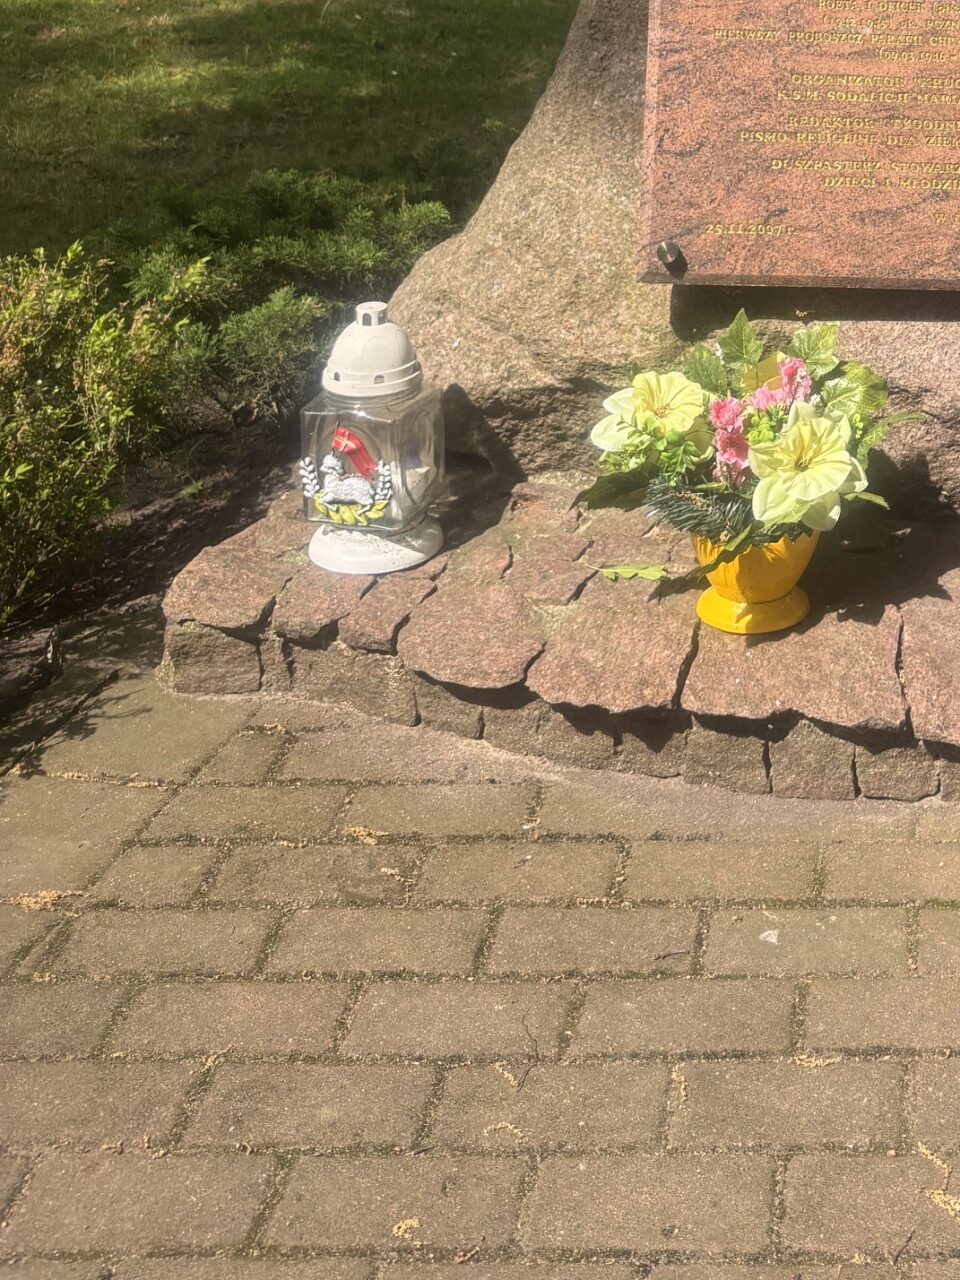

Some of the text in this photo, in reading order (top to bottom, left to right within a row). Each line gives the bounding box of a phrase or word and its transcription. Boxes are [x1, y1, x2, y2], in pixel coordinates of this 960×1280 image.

[818, 0, 858, 11] POETA
[878, 1, 924, 13] OFICER
[714, 29, 781, 41] PIERWSZY
[788, 31, 863, 44] PROBOSZCZ
[871, 34, 923, 46] PARAFII
[791, 74, 904, 87] ORGANIZATOR
[827, 91, 908, 103] SODALICJI
[789, 116, 875, 129] REDAKTOR
[740, 131, 787, 143] PISMO
[887, 135, 917, 146] DLA
[771, 159, 881, 171] DUSZPASTERZ
[824, 177, 876, 189] DZIECI
[706, 224, 782, 237] 25.11.2007
